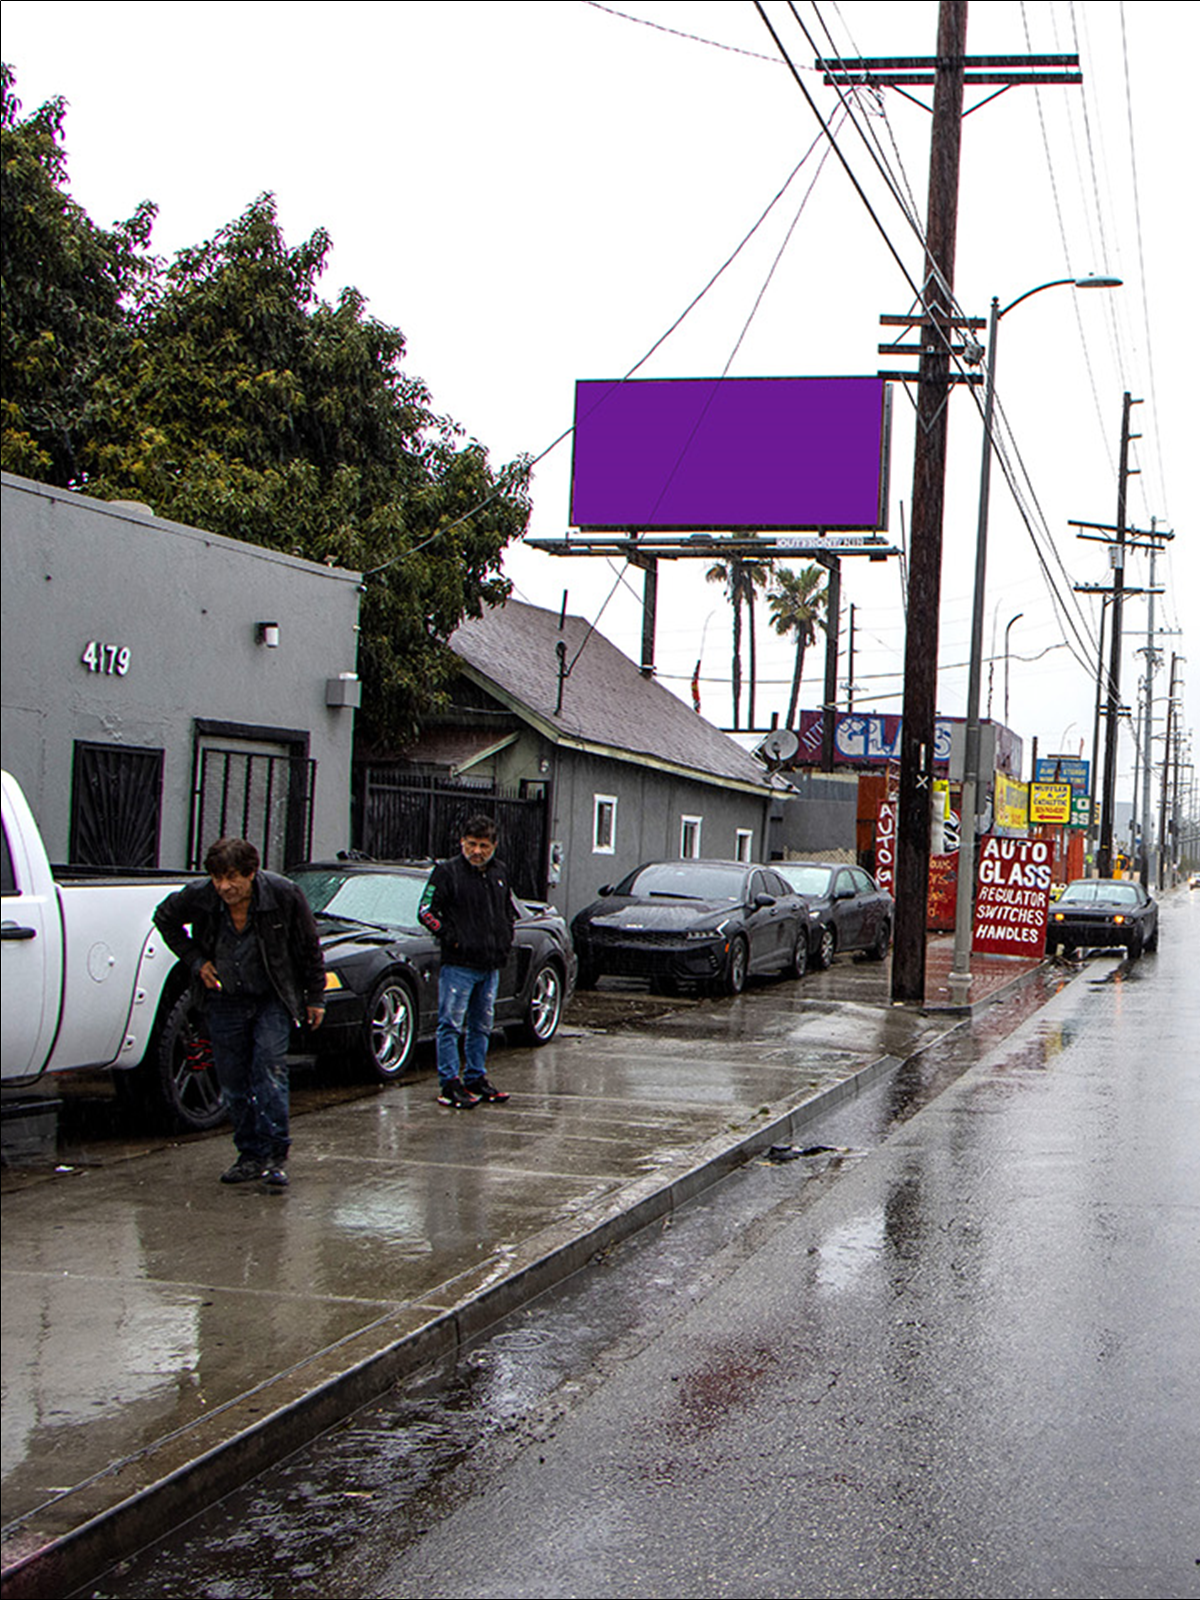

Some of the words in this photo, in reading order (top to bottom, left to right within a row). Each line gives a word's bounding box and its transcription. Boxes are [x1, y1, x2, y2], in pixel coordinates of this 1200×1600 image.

[82, 641, 131, 676] 4179
[801, 717, 824, 753] AUT
[983, 838, 1048, 863] AUTO
[979, 859, 1052, 890] GLASS
[978, 886, 1046, 908] REGULATOR
[976, 904, 1045, 927] SWITCHES
[975, 923, 1040, 944] HANDLES
